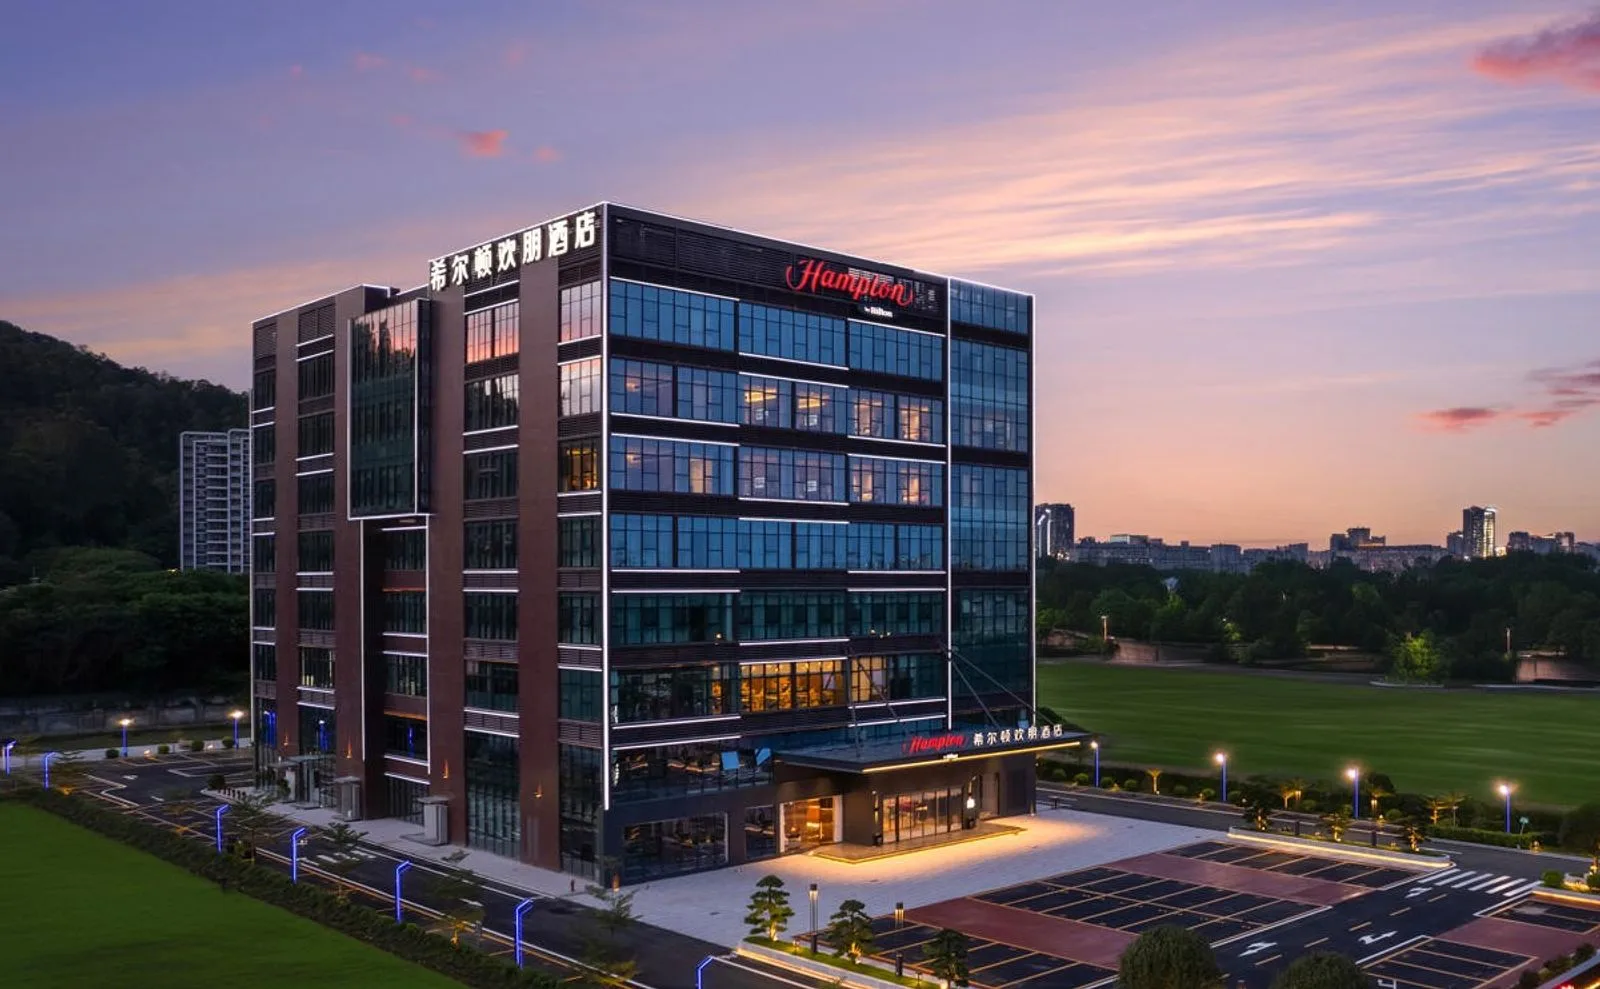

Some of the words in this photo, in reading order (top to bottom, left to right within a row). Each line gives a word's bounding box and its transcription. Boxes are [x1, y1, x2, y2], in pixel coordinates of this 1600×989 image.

[430, 211, 596, 291] 希尔顿欢朋酒店
[785, 259, 914, 306] Hampton
[973, 723, 1063, 747] 希尔顿欢朋酒店
